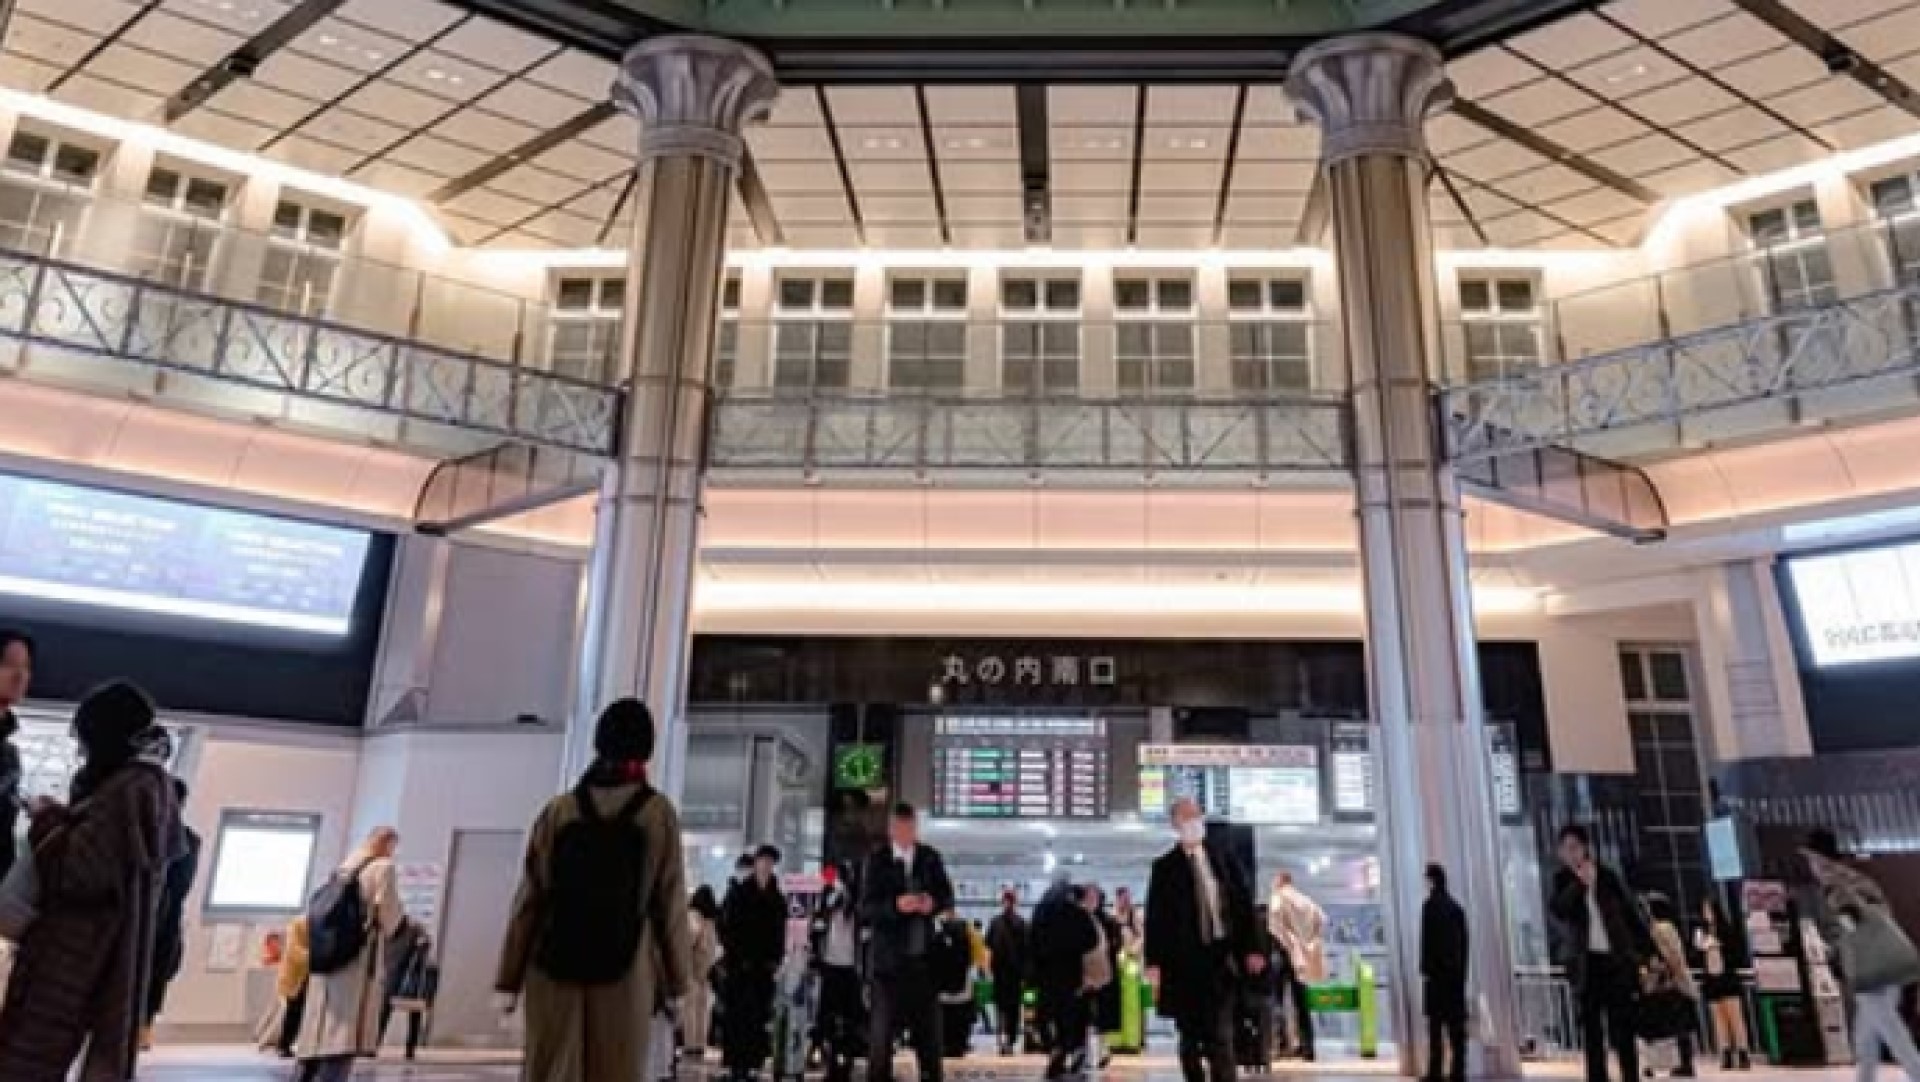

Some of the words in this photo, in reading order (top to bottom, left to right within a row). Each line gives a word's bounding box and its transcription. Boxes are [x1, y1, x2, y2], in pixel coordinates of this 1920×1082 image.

[942, 654, 1115, 685] 丸の内南口
